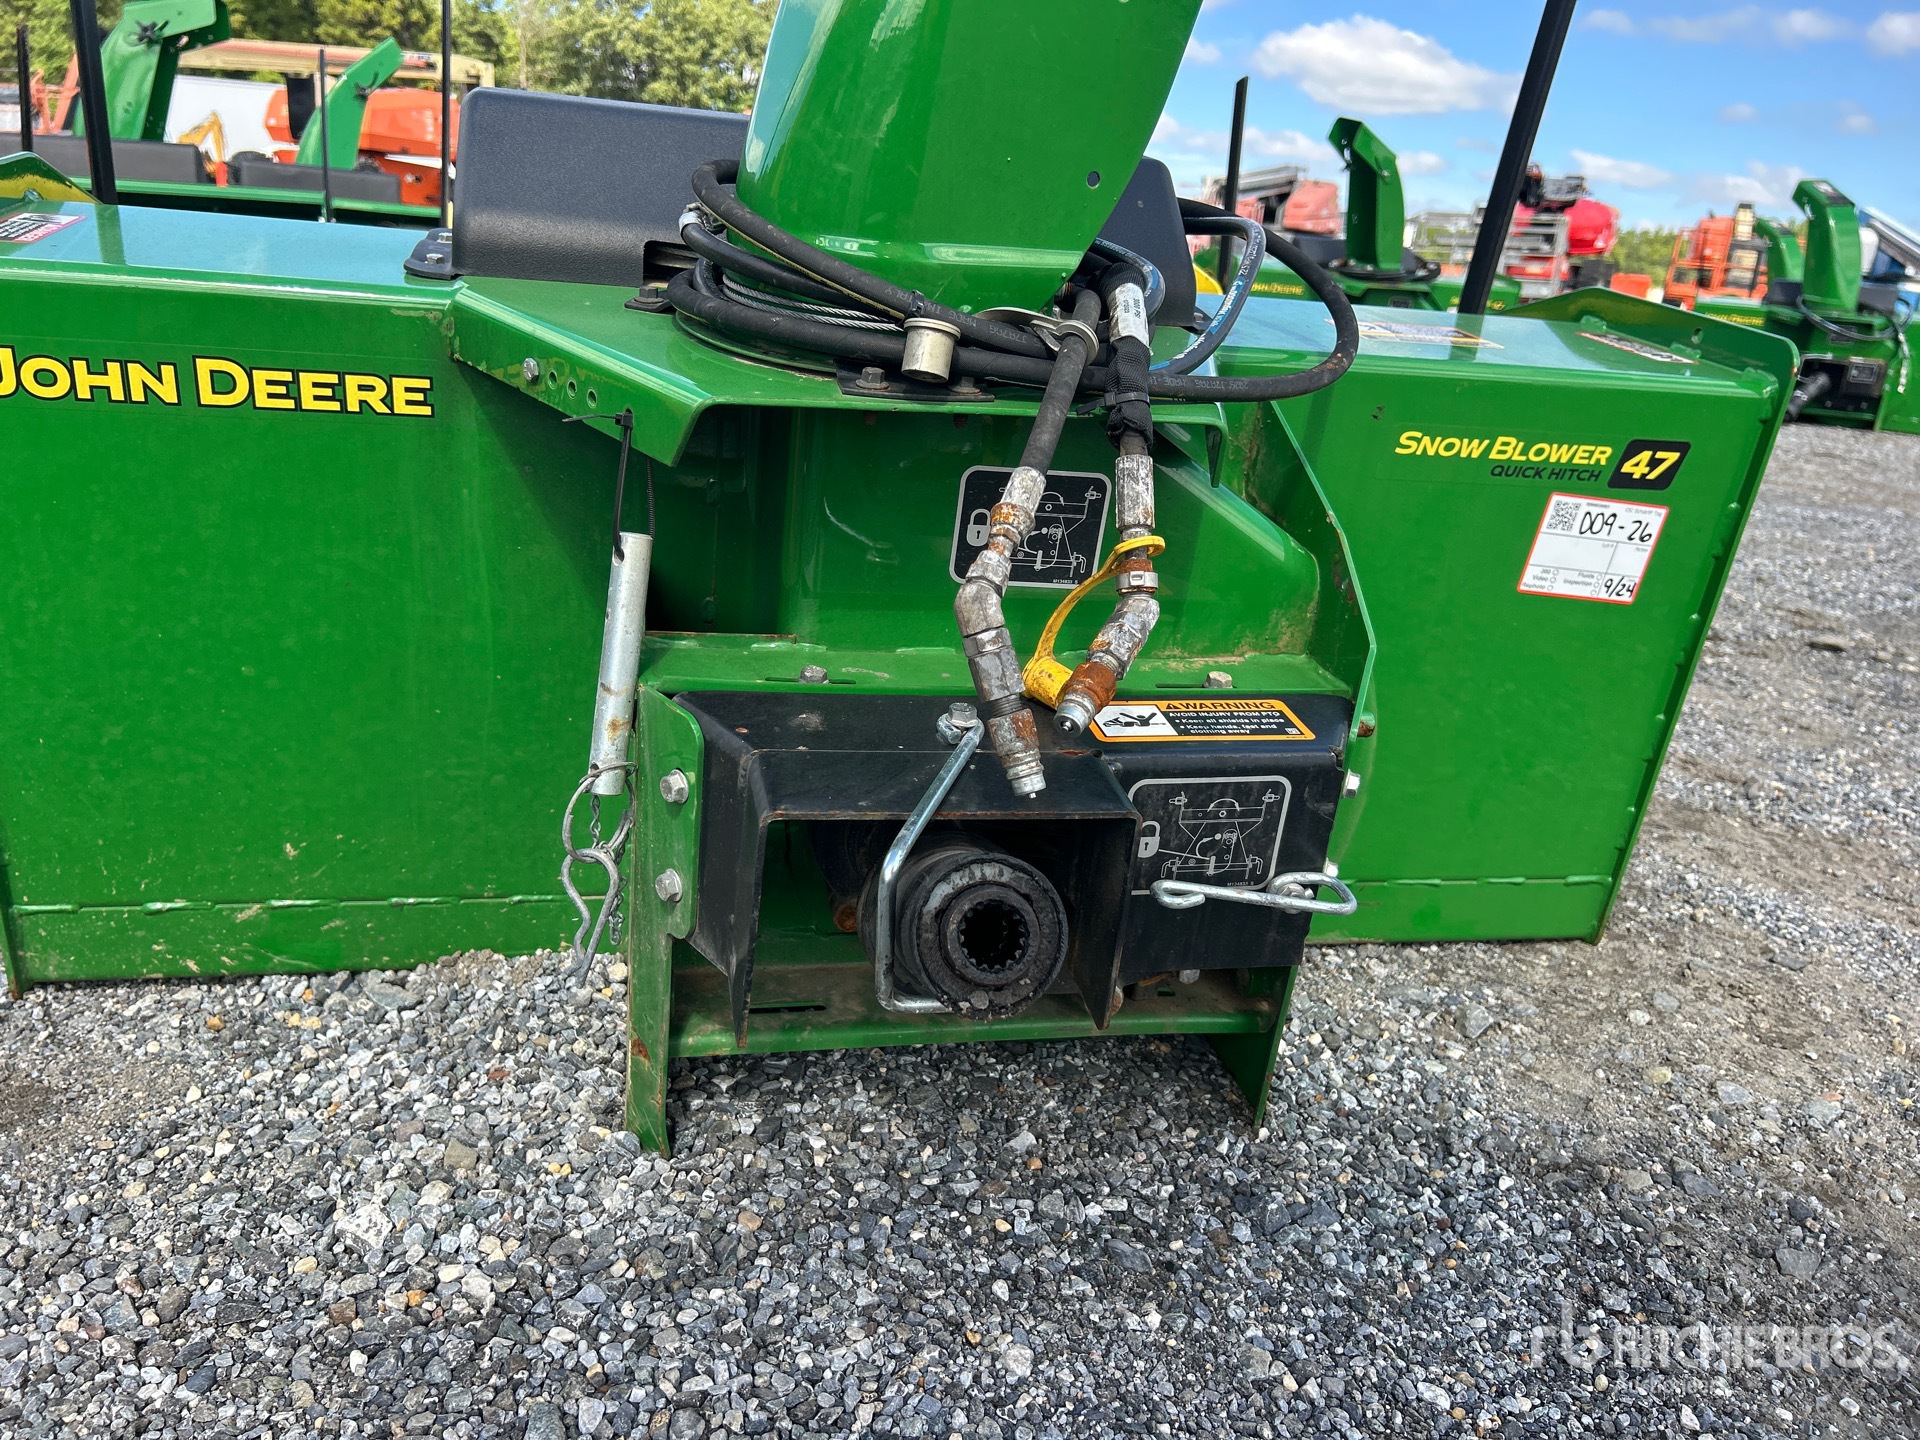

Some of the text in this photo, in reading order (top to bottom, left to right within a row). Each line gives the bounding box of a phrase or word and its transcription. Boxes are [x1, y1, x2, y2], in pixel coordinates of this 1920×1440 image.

[192, 355, 435, 418] DEERE
[1395, 431, 1680, 480] SNOW BLOWER 47
[1490, 465, 1602, 482] QUICK HITCH
[1604, 576, 1637, 598] 9/24
[1179, 701, 1276, 710] WARNING
